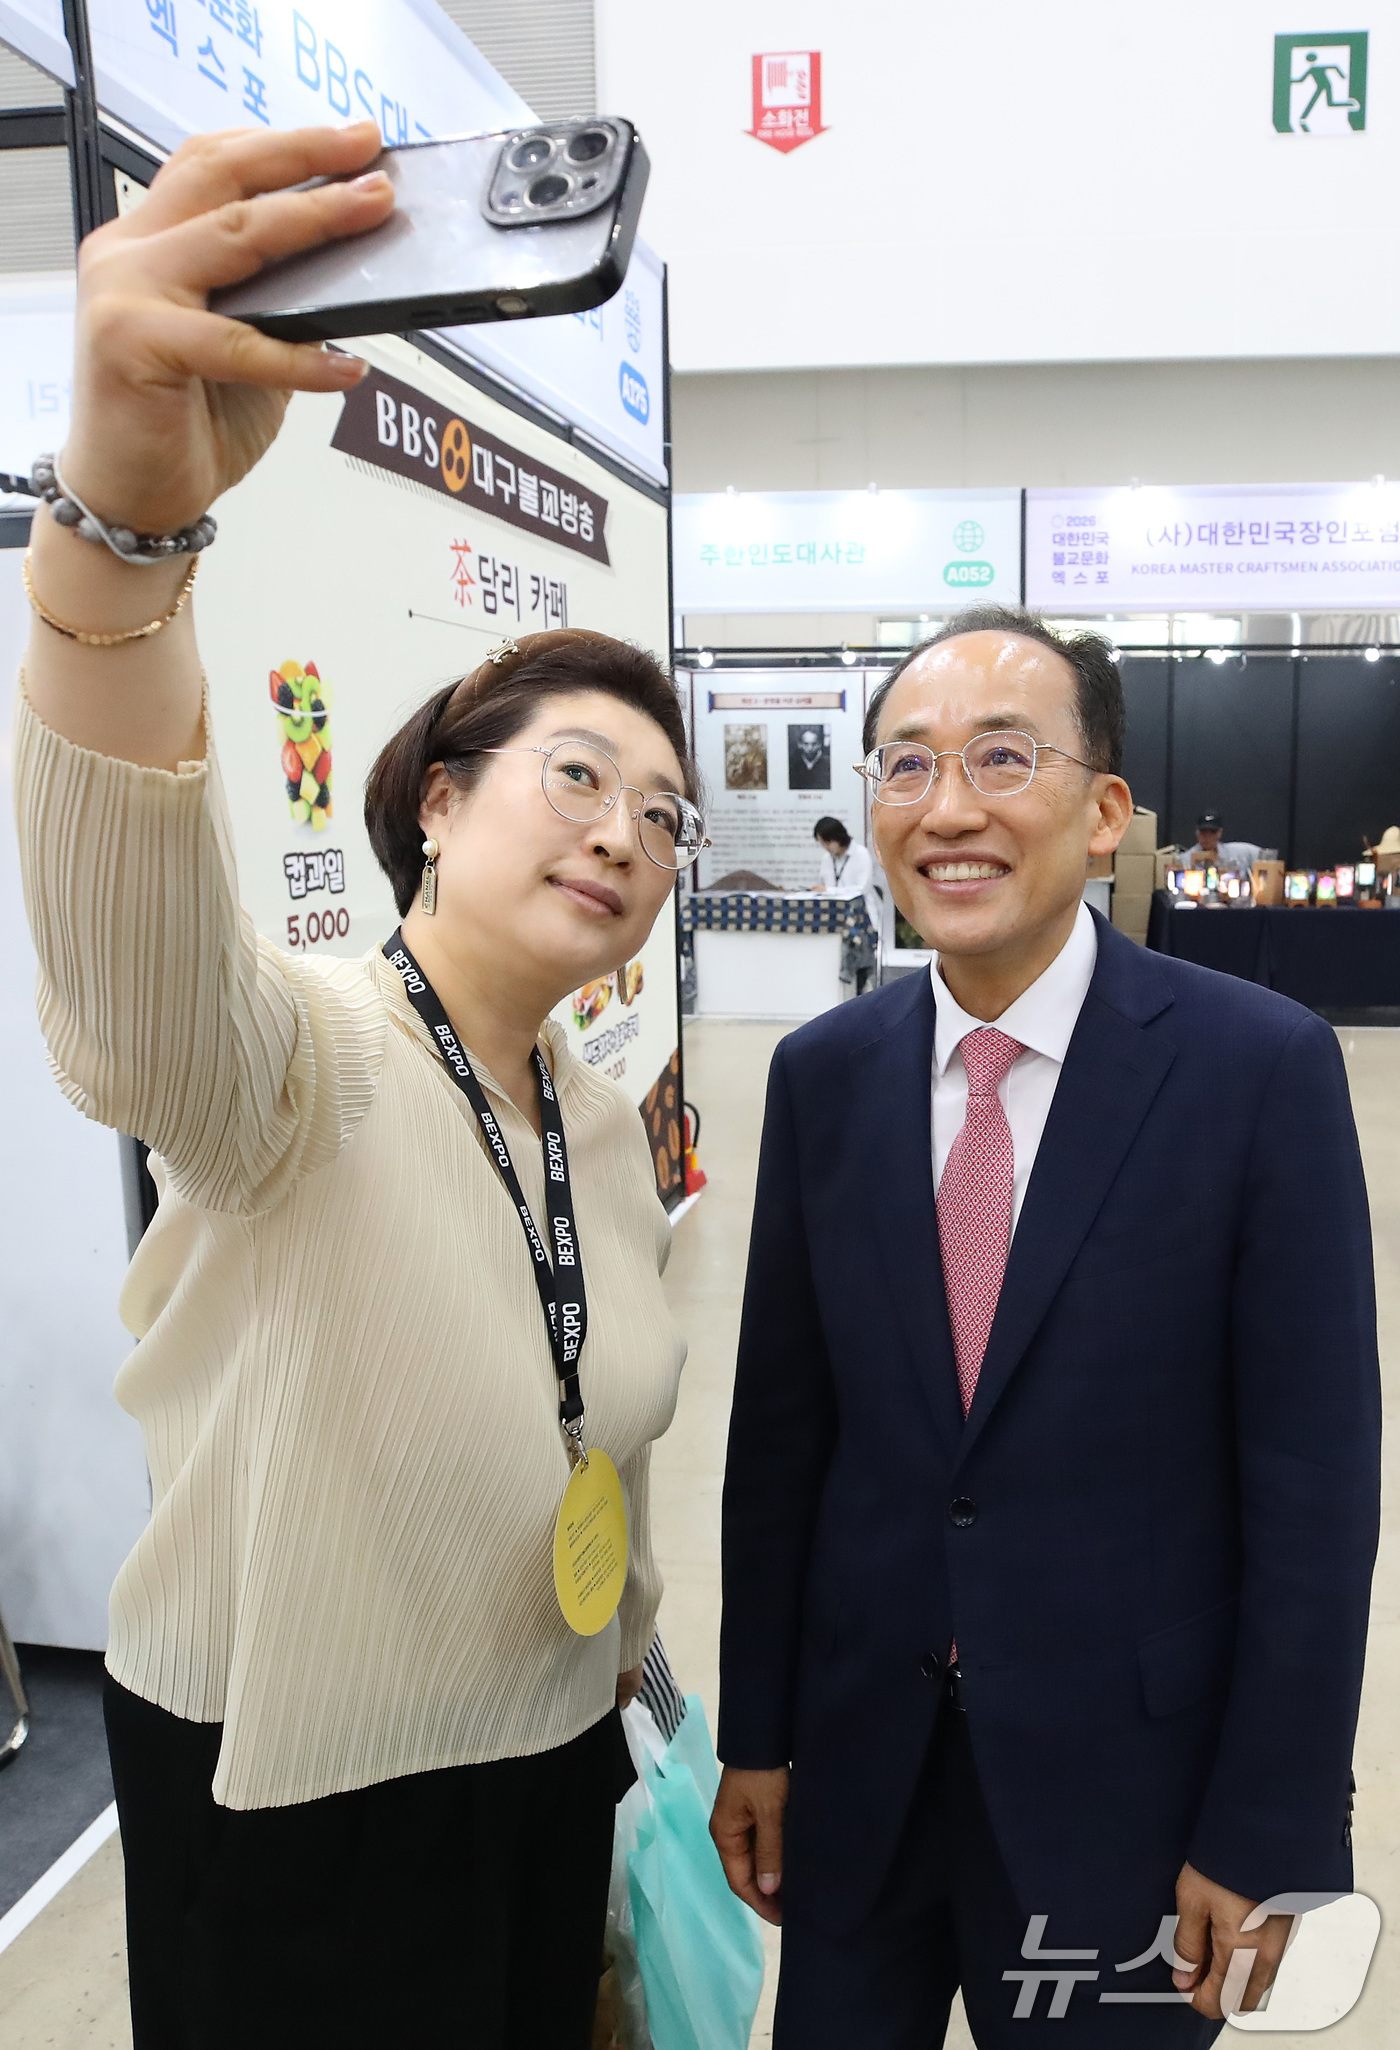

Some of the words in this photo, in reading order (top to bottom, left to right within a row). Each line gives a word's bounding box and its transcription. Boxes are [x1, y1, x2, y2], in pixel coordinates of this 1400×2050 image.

[293, 8, 433, 147] BBS대
[761, 107, 809, 128] 소화전
[376, 390, 439, 468] BBS
[472, 443, 594, 542] 대구불교방송
[1052, 531, 1109, 546] 대한민국
[1066, 515, 1096, 527] 2026
[700, 541, 866, 566] 주한인도대사관
[947, 566, 991, 582] A052
[1053, 550, 1109, 566] 불교문화
[1131, 563, 1176, 575] KOREA
[1180, 562, 1234, 574] MASTER
[1237, 561, 1318, 574] CRAFTSMEN
[530, 574, 568, 629] 카페
[284, 849, 345, 899] 컵과일
[287, 908, 350, 951] 5,000
[389, 949, 426, 994] BEXPO
[434, 1024, 470, 1078] BEXPO
[536, 1054, 555, 1102] BEXPO
[481, 1112, 510, 1168] BEXPO
[546, 1131, 565, 1182] BEXPO
[519, 1205, 545, 1262] BEXPO
[553, 1216, 576, 1266] BEXPO
[562, 1302, 581, 1362] BEXPO
